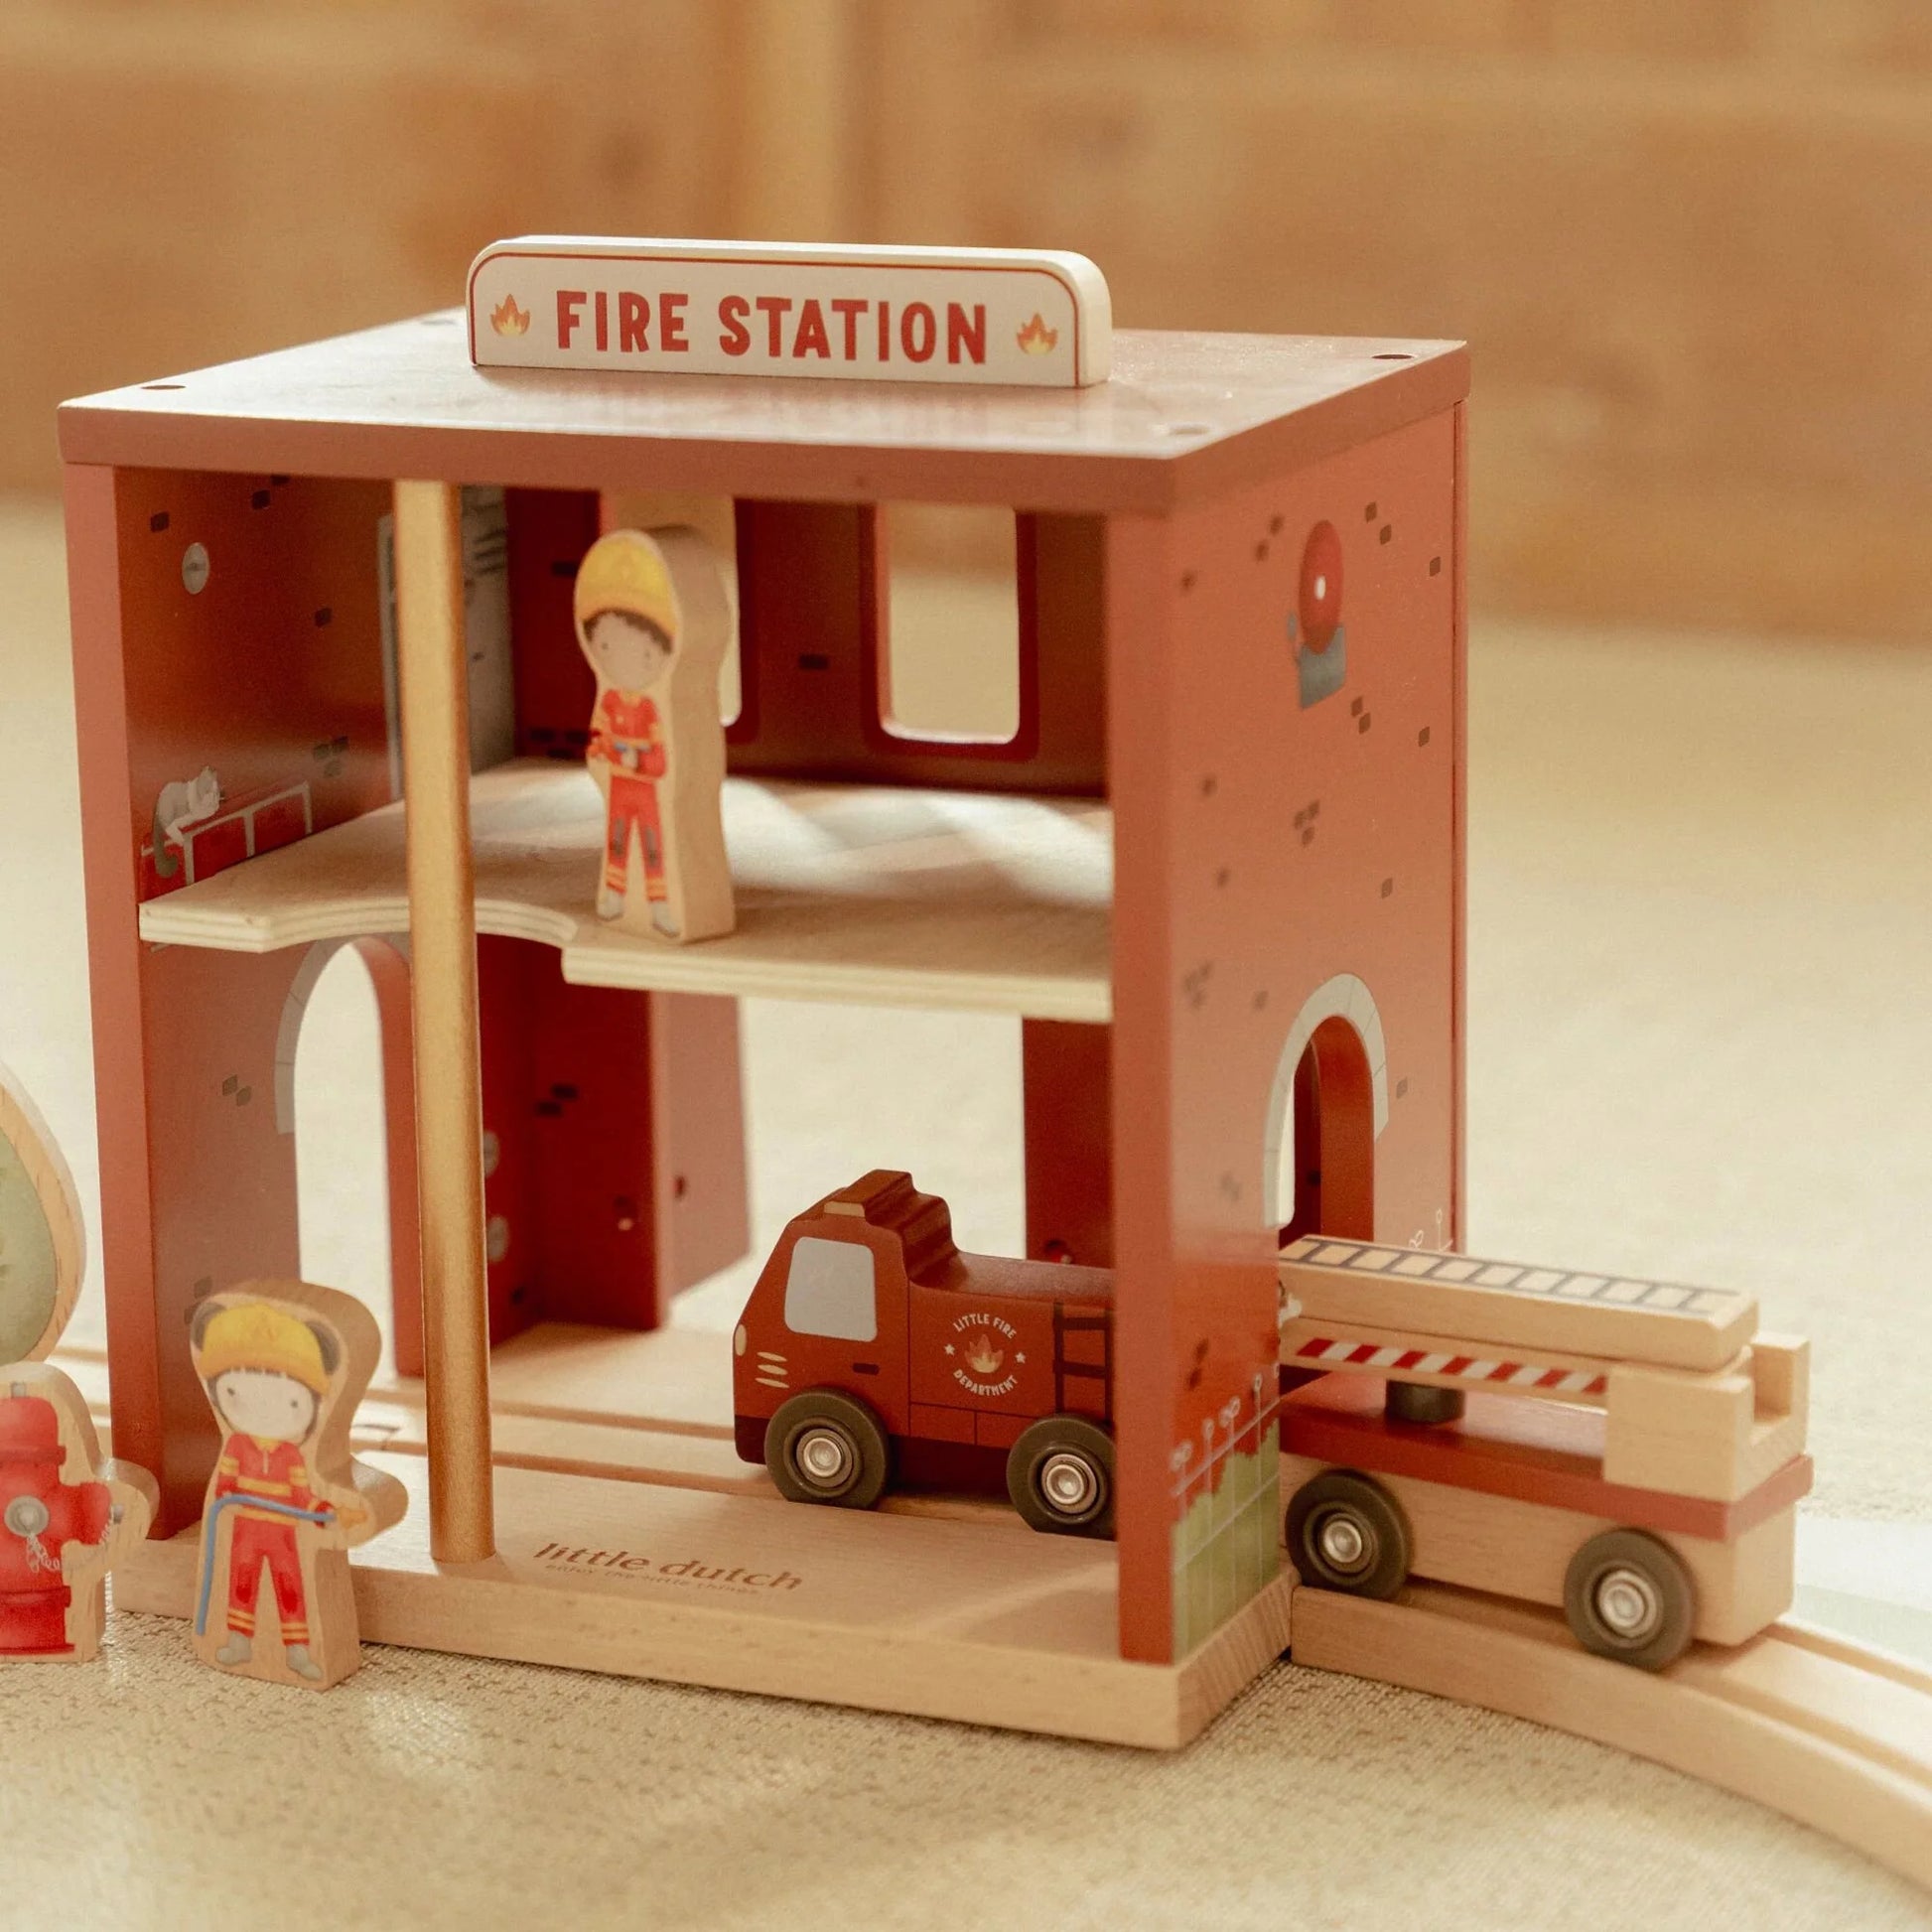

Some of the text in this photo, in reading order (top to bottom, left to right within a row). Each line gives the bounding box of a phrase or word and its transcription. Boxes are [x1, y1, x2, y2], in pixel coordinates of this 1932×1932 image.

[555, 289, 987, 365] FIRE STATION
[952, 1312, 1018, 1339] LITTLE FIRE
[953, 1368, 1019, 1397] DEPARTMENT
[533, 1542, 803, 1590] little dutch
